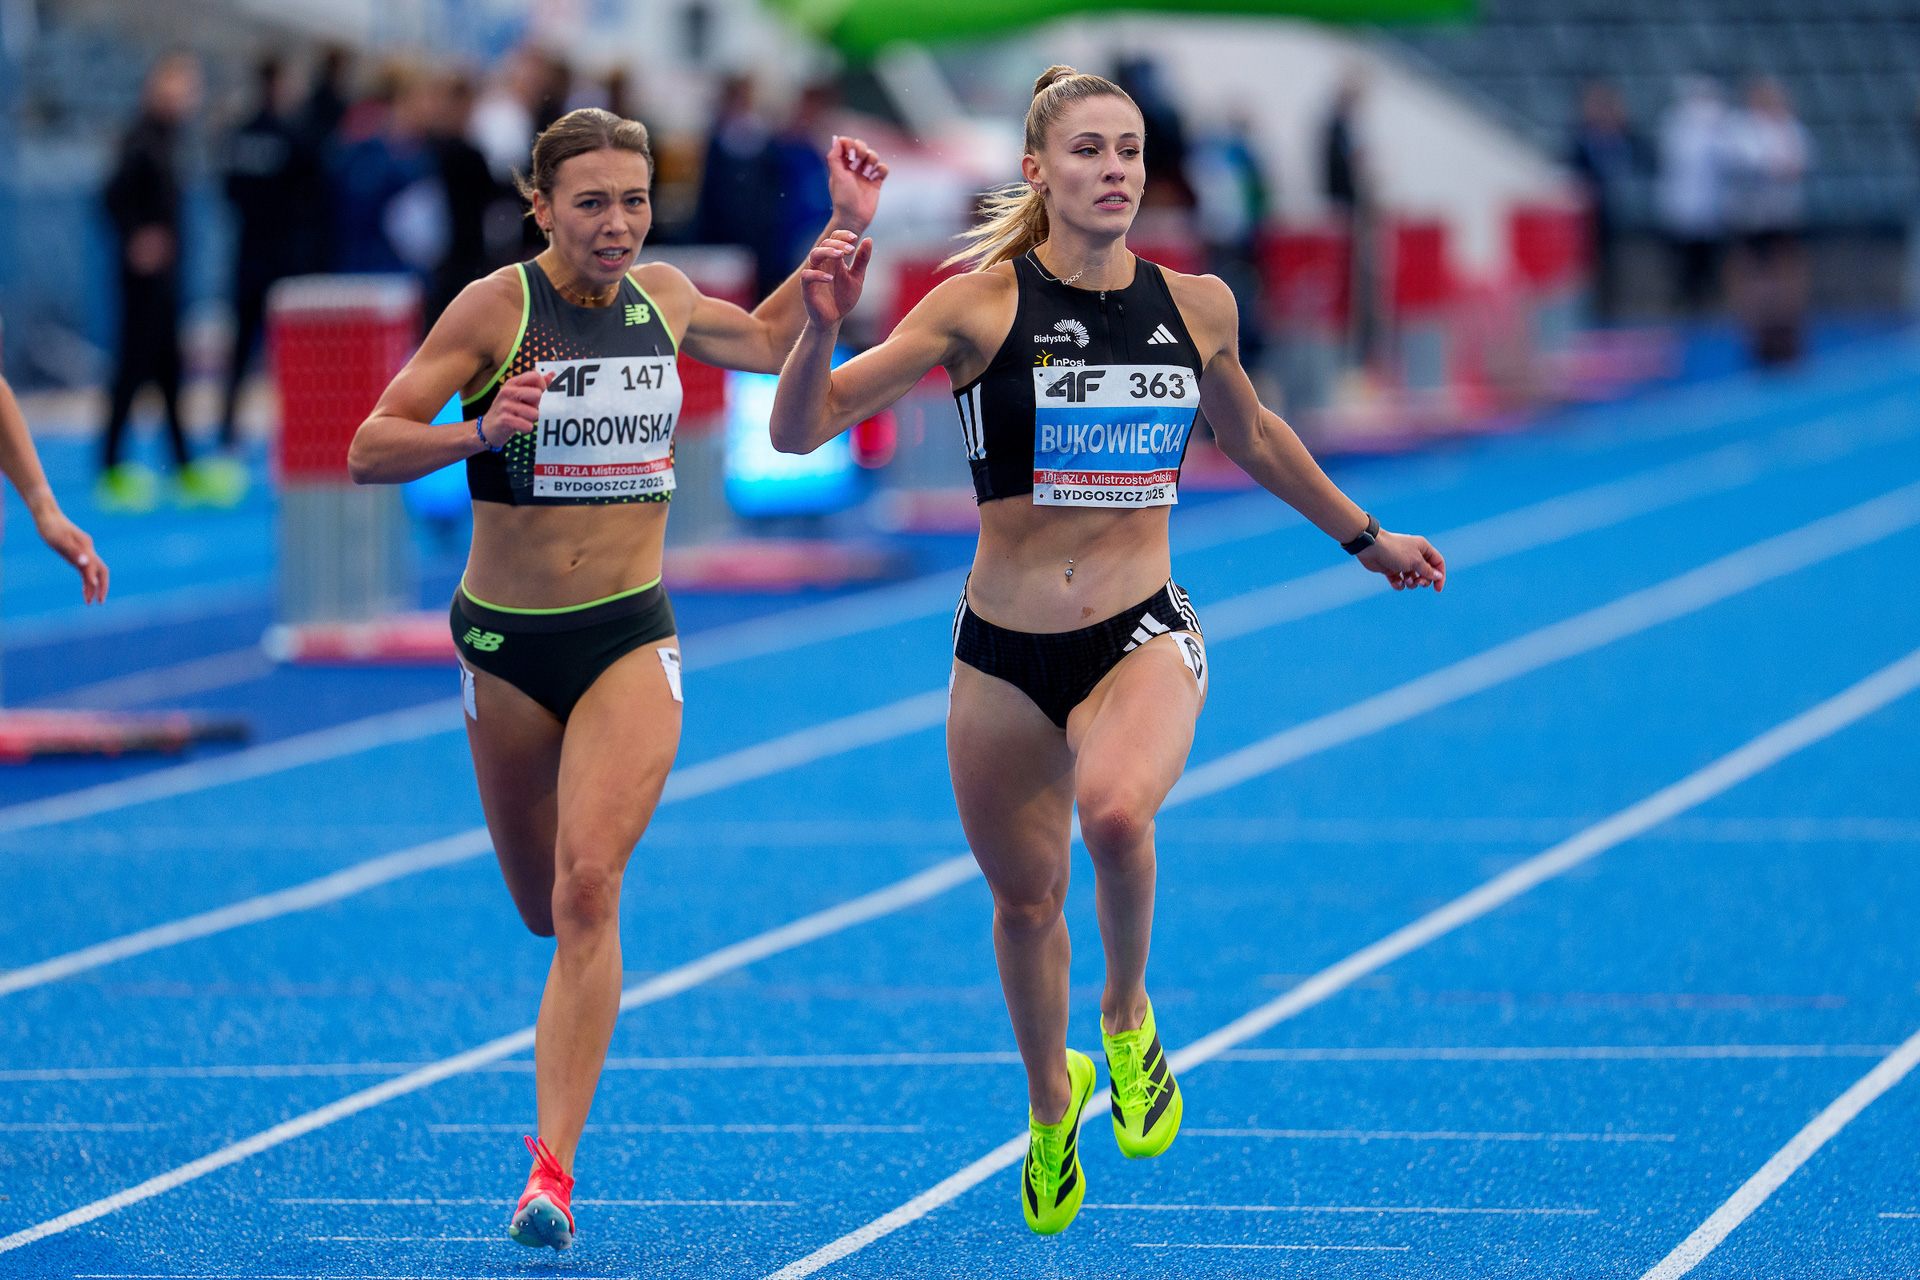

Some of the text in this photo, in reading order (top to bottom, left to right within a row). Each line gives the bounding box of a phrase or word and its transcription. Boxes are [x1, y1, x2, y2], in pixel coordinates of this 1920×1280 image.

[1033, 333, 1072, 345] Białystok
[1053, 358, 1086, 367] InPost
[547, 364, 601, 397] 4F
[621, 364, 664, 391] 147
[1045, 370, 1107, 403] 4F
[1129, 372, 1186, 399] 363
[542, 413, 673, 447] HOROWSKA
[1041, 423, 1185, 455] BUKOWIECKA
[543, 465, 561, 475] 101.
[563, 465, 587, 476] PZLA
[591, 464, 650, 476] Mistrzostwa
[1062, 474, 1088, 484] PZLA
[554, 476, 664, 492] BYDGOSZCZ 2025
[1053, 489, 1143, 502] BYDGOSZCZ
